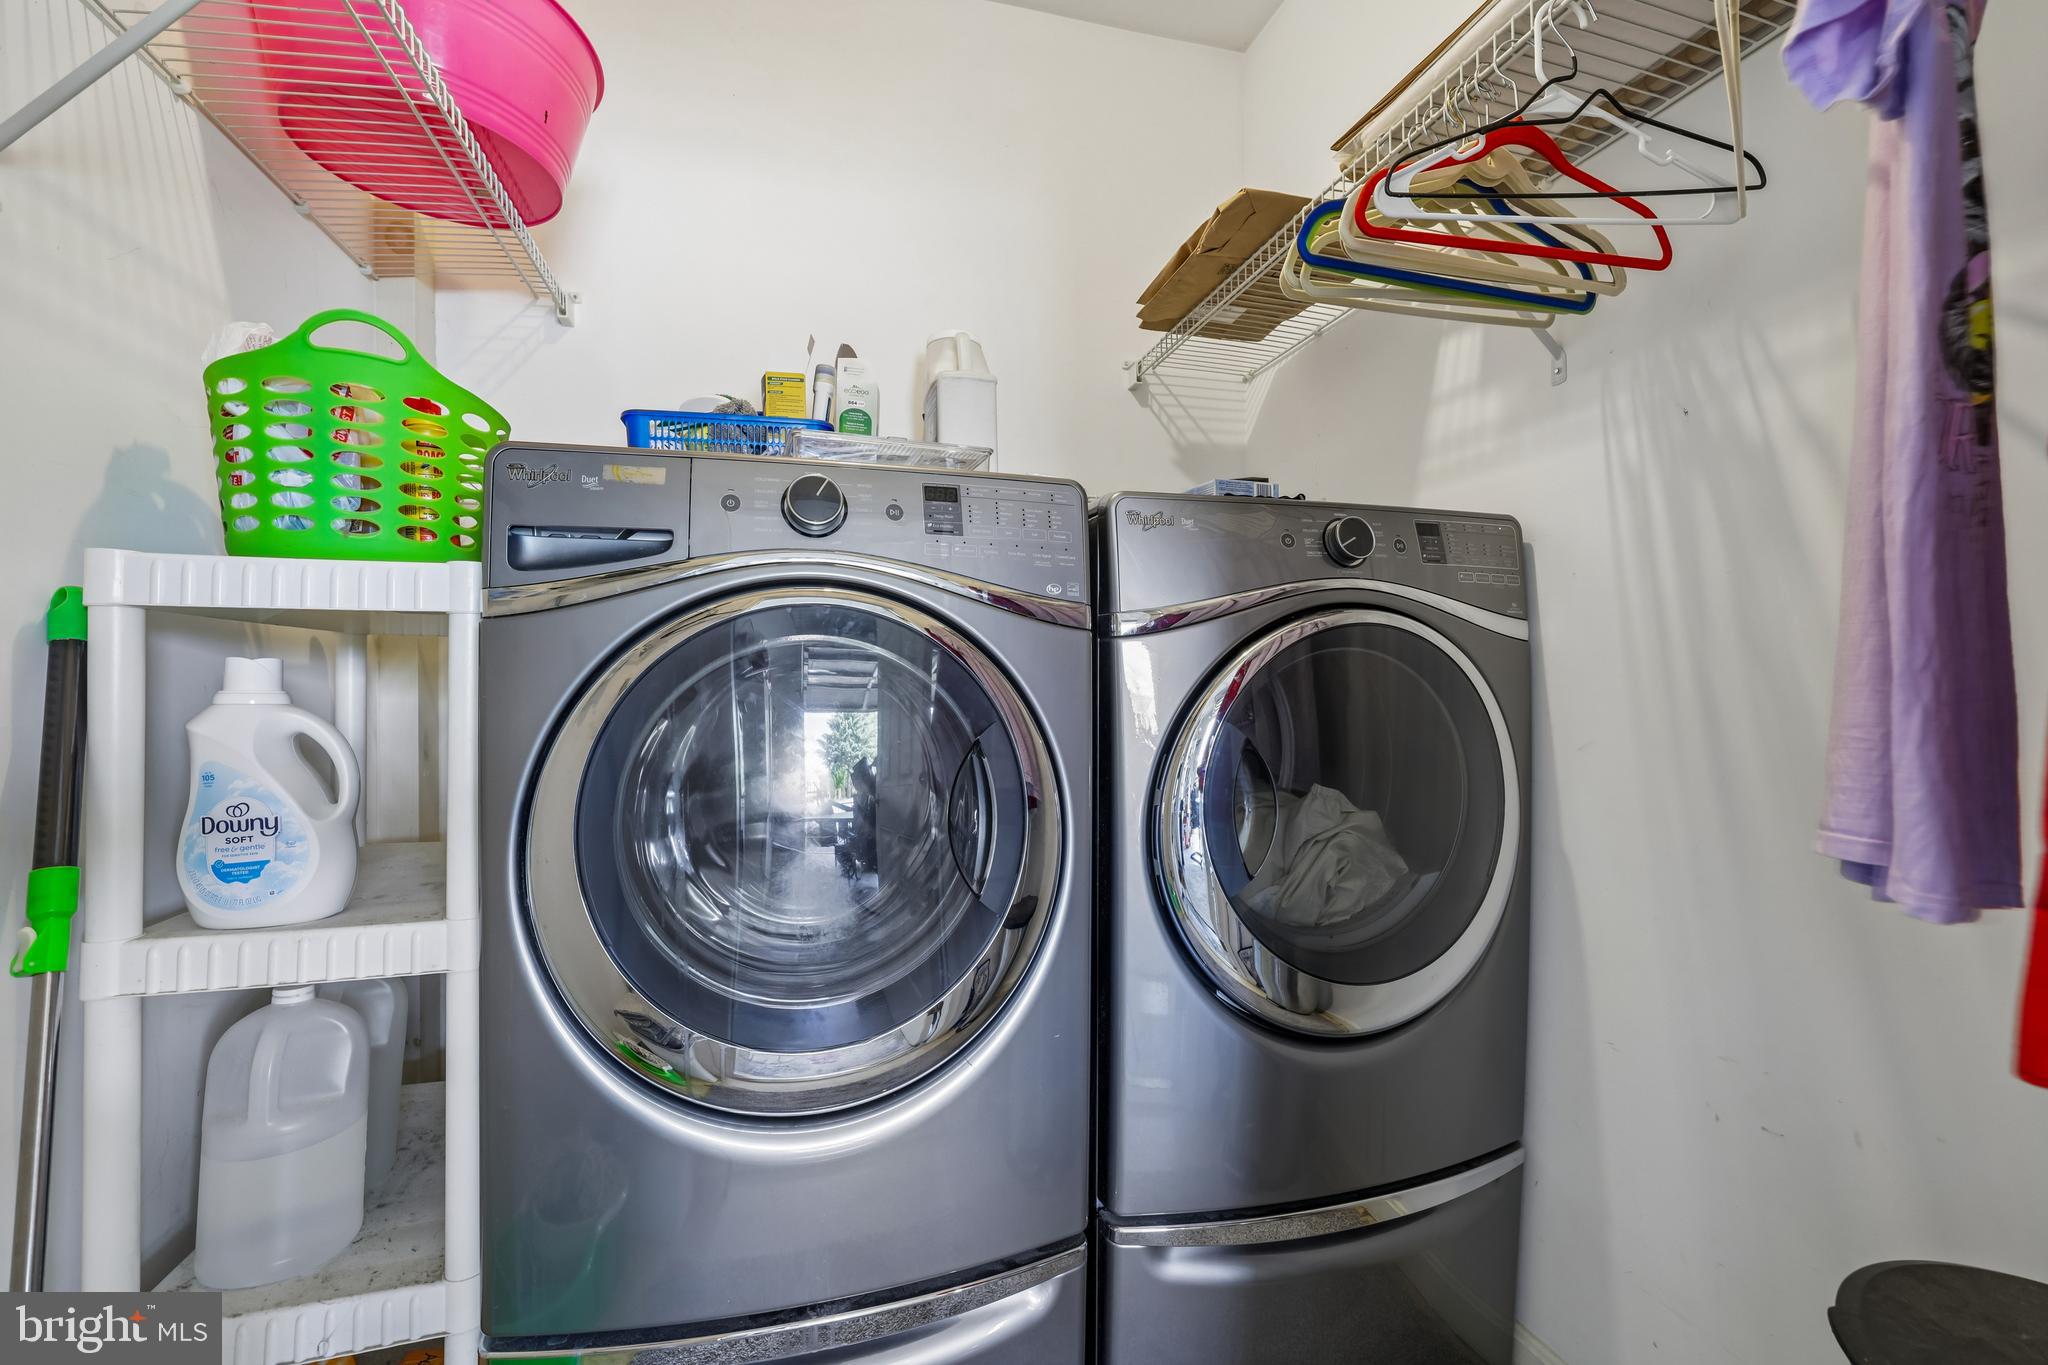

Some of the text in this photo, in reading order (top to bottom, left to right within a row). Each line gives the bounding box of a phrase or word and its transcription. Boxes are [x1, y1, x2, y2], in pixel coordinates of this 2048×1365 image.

[506, 463, 573, 488] Whirlpool
[581, 474, 599, 483] Duet
[1125, 510, 1175, 531] Whirlpool
[201, 816, 279, 837] Downy
[225, 836, 254, 845] SOFT
[239, 843, 266, 852] gentle
